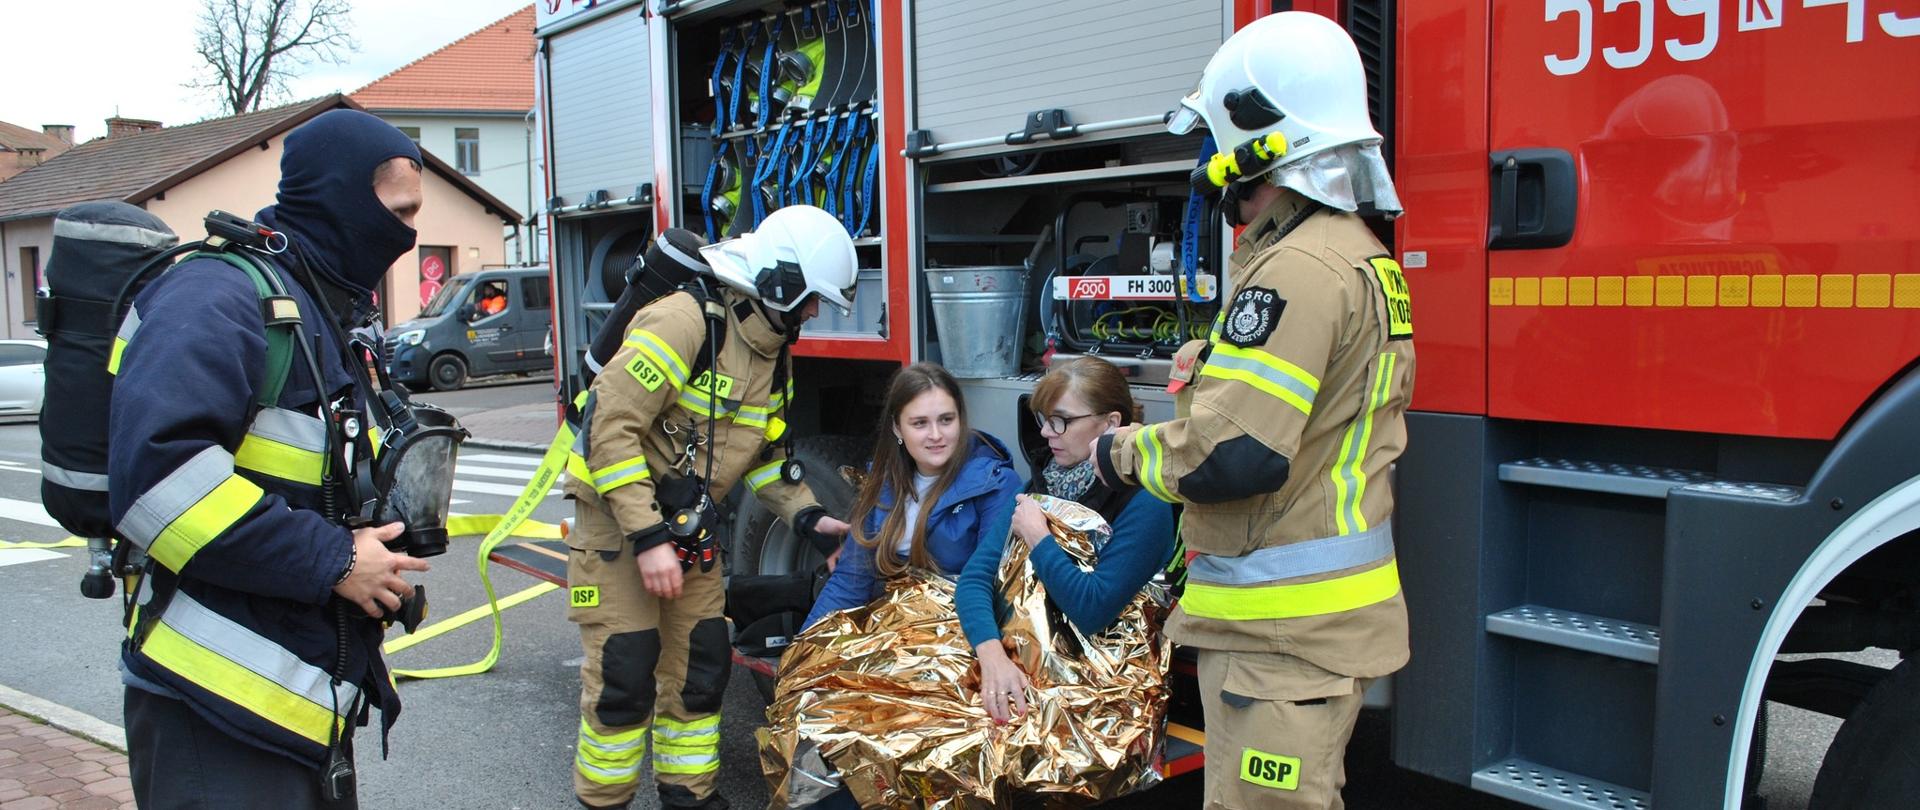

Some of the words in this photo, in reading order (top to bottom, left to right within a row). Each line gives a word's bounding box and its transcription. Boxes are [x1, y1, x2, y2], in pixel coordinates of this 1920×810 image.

[1128, 280, 1144, 293] FH
[1148, 280, 1176, 293] 300
[1237, 290, 1273, 304] KSRG
[632, 360, 659, 385] OSP
[573, 590, 595, 604] OSP
[1248, 755, 1293, 783] OSP
